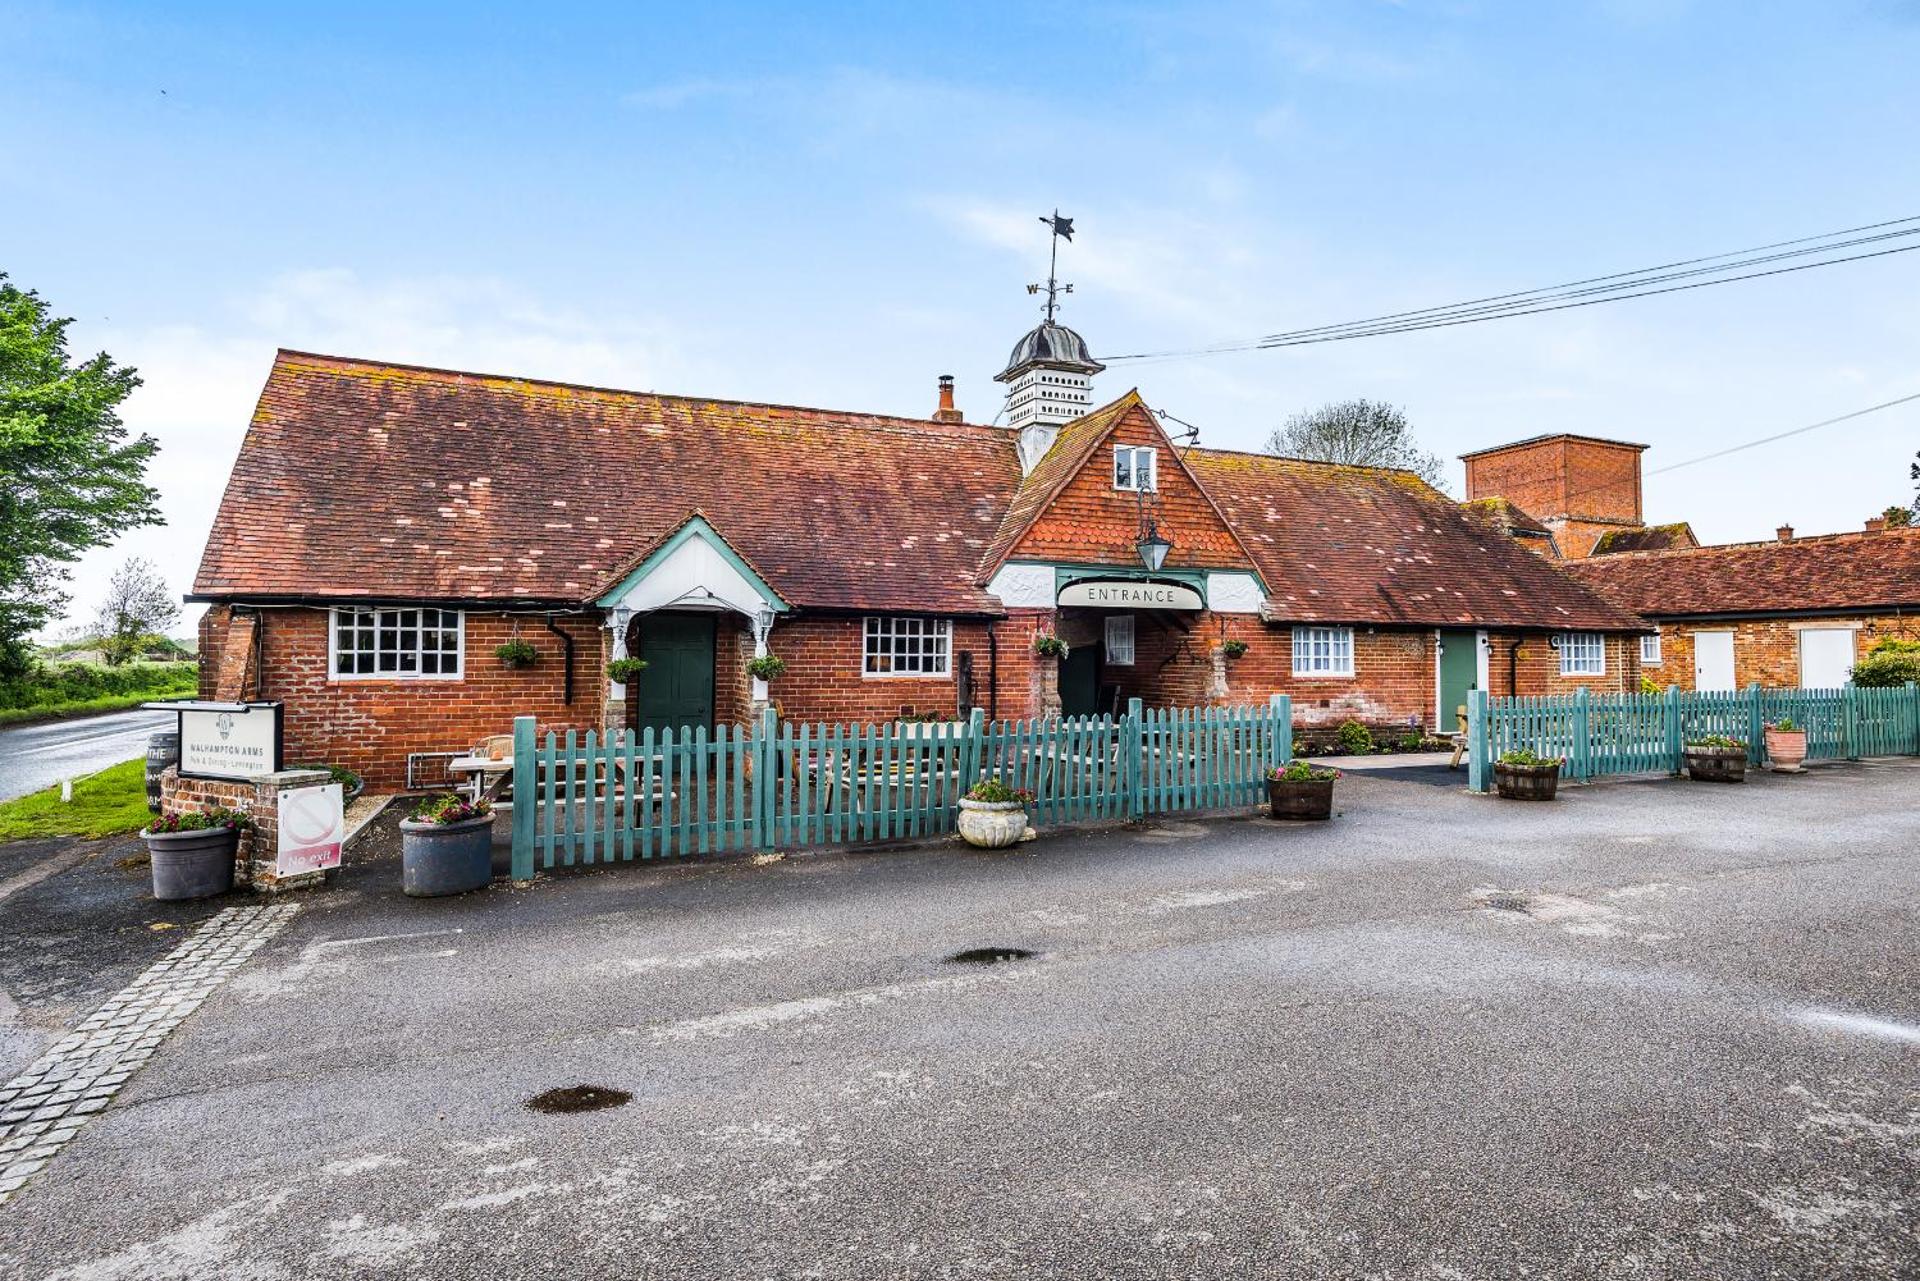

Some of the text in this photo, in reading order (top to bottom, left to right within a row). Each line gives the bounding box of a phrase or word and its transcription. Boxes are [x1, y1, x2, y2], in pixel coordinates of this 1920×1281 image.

[1026, 283, 1074, 295] W E
[1088, 588, 1175, 602] ENTRANCE
[190, 743, 264, 757] WALHAMPTON ARMS
[288, 850, 332, 867] No exit
